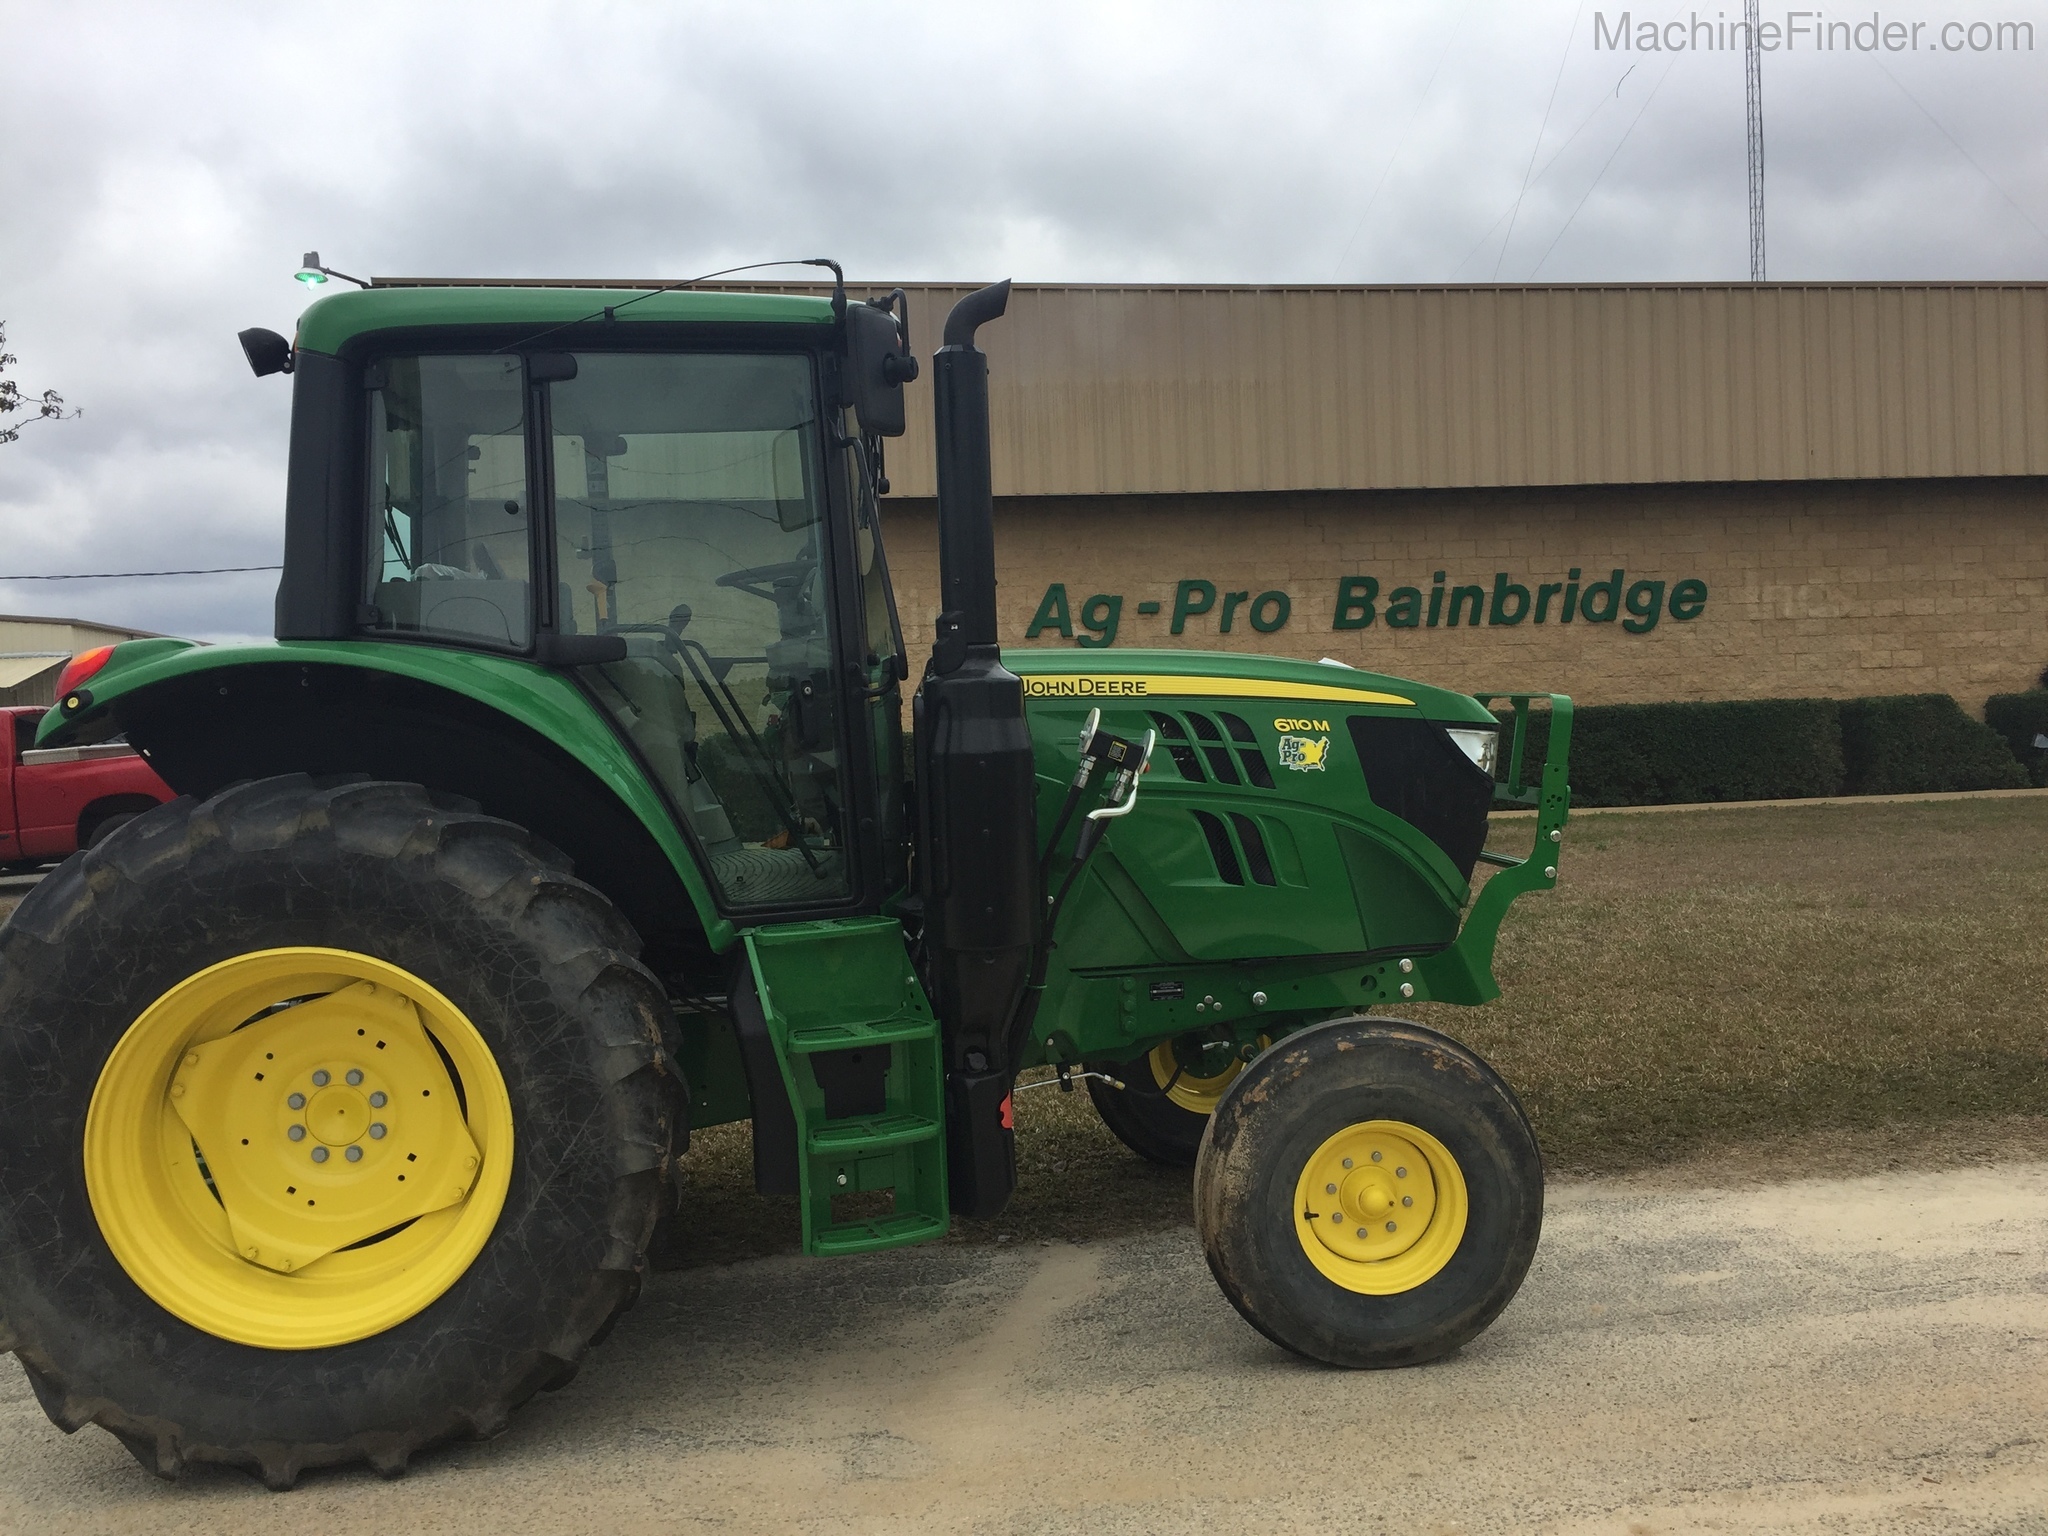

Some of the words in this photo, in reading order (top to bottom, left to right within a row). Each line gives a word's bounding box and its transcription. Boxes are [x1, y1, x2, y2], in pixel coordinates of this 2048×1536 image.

[1332, 567, 1709, 634] Bainbridge
[1024, 678, 1075, 694] JOHN
[1078, 678, 1147, 694] DEERE
